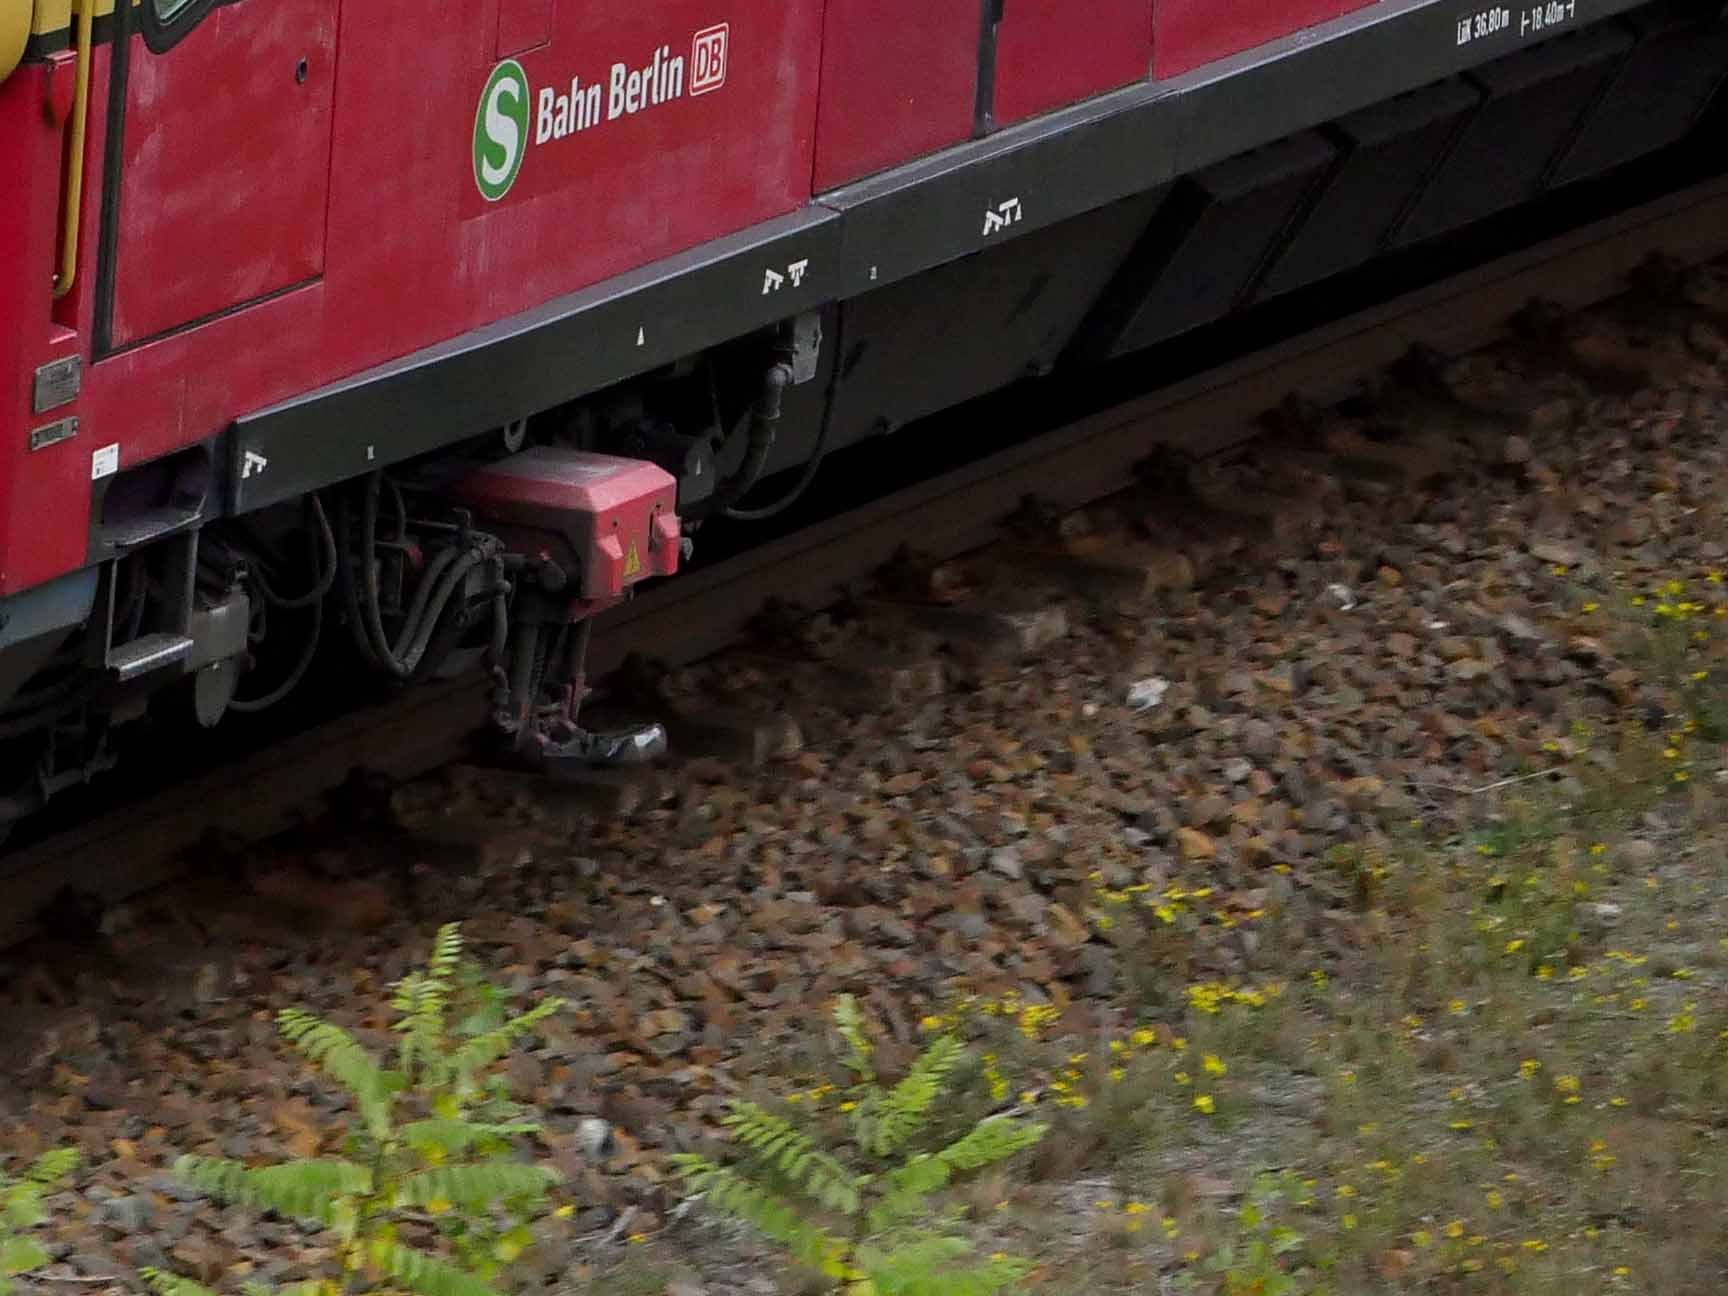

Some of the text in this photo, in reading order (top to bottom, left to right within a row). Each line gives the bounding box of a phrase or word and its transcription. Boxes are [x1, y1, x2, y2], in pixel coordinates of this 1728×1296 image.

[480, 32, 724, 188] S Bahn Berlin DB
